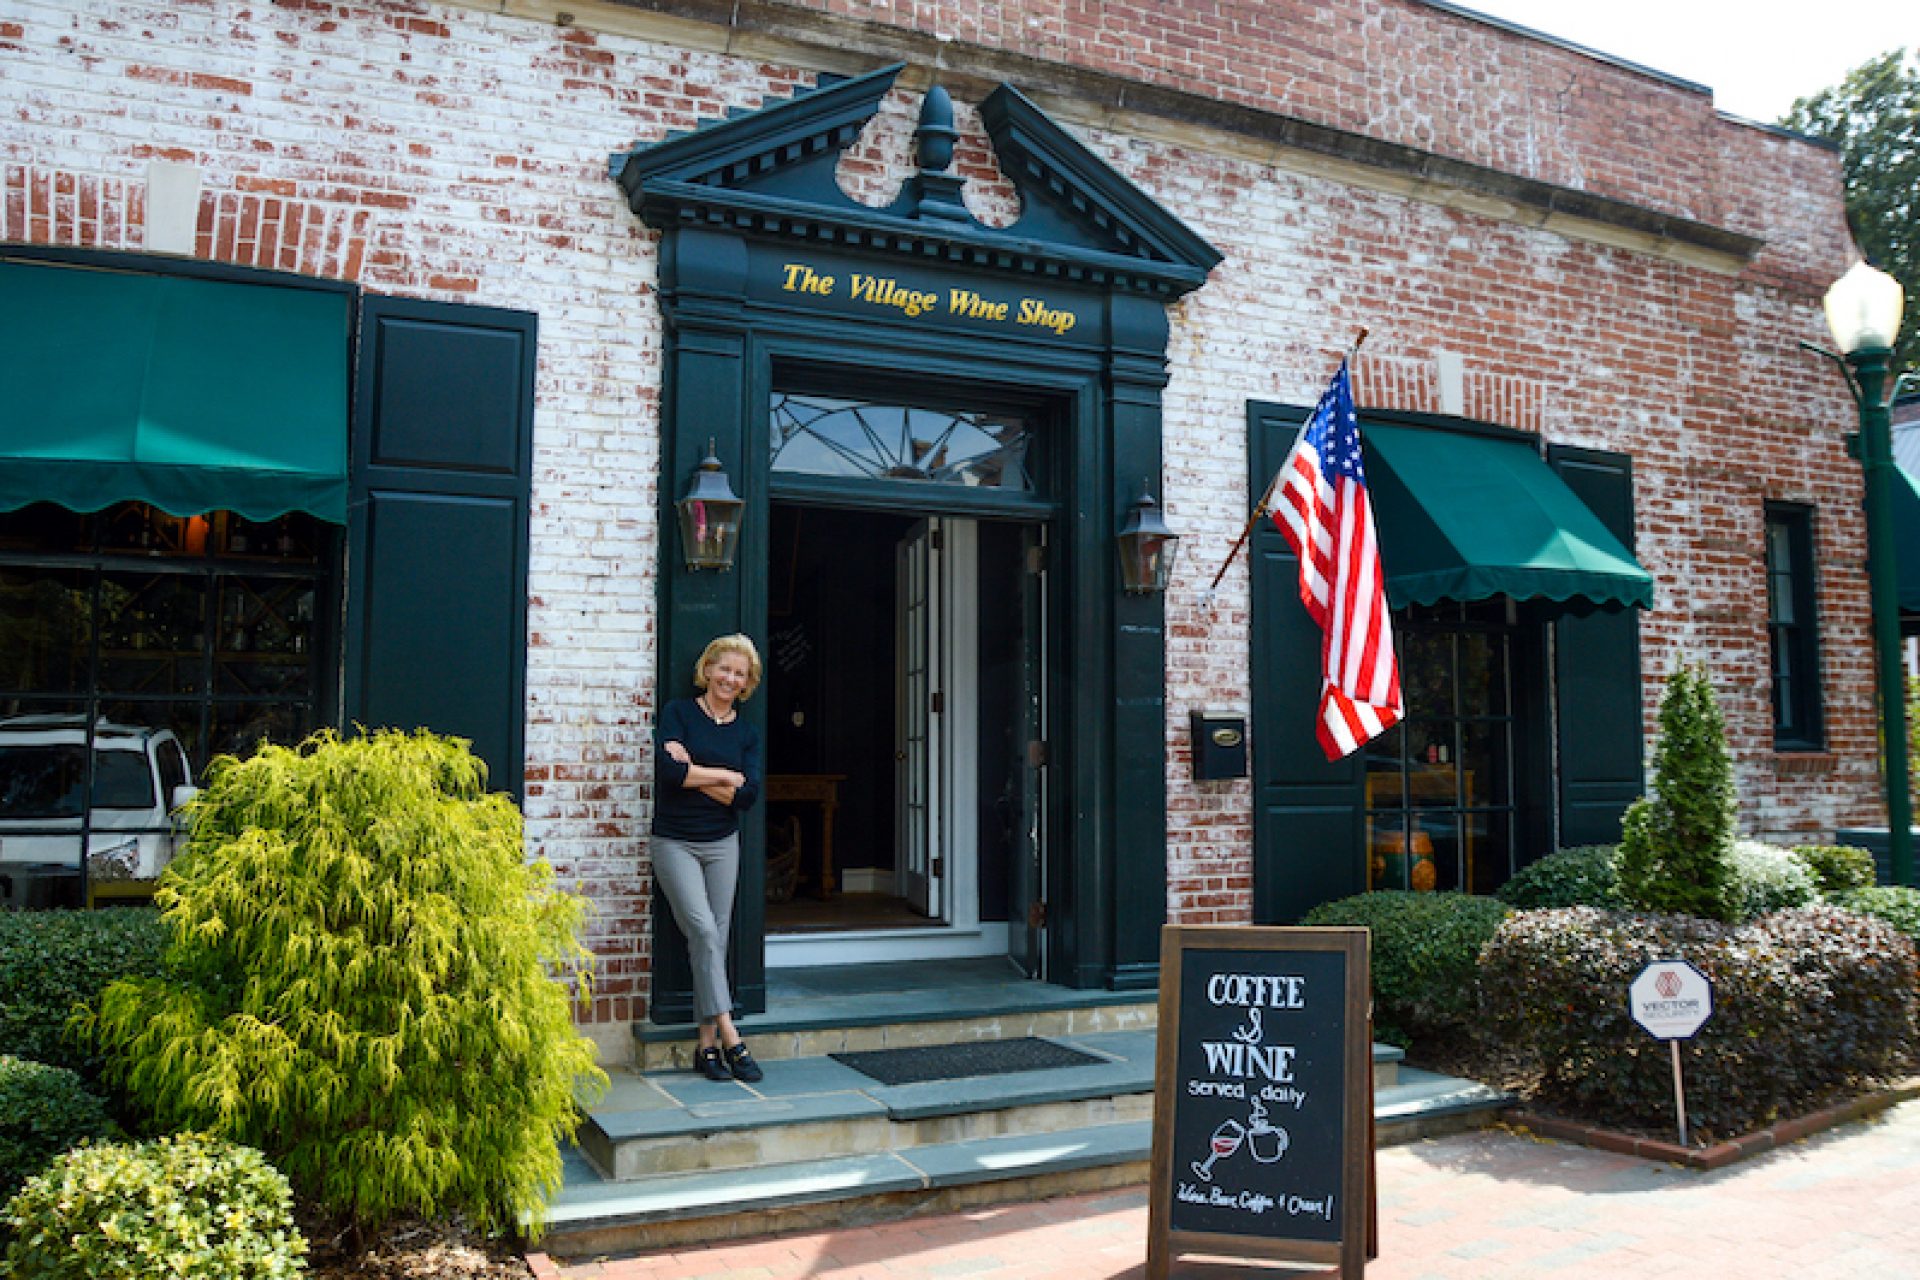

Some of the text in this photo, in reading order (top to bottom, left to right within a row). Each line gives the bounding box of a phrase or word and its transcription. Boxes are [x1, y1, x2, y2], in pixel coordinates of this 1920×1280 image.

[782, 263, 1076, 335] The Village Wine Shop
[1208, 974, 1304, 1008] COFFEE
[1202, 1042, 1295, 1082] WINE
[1260, 1083, 1305, 1110] daily
